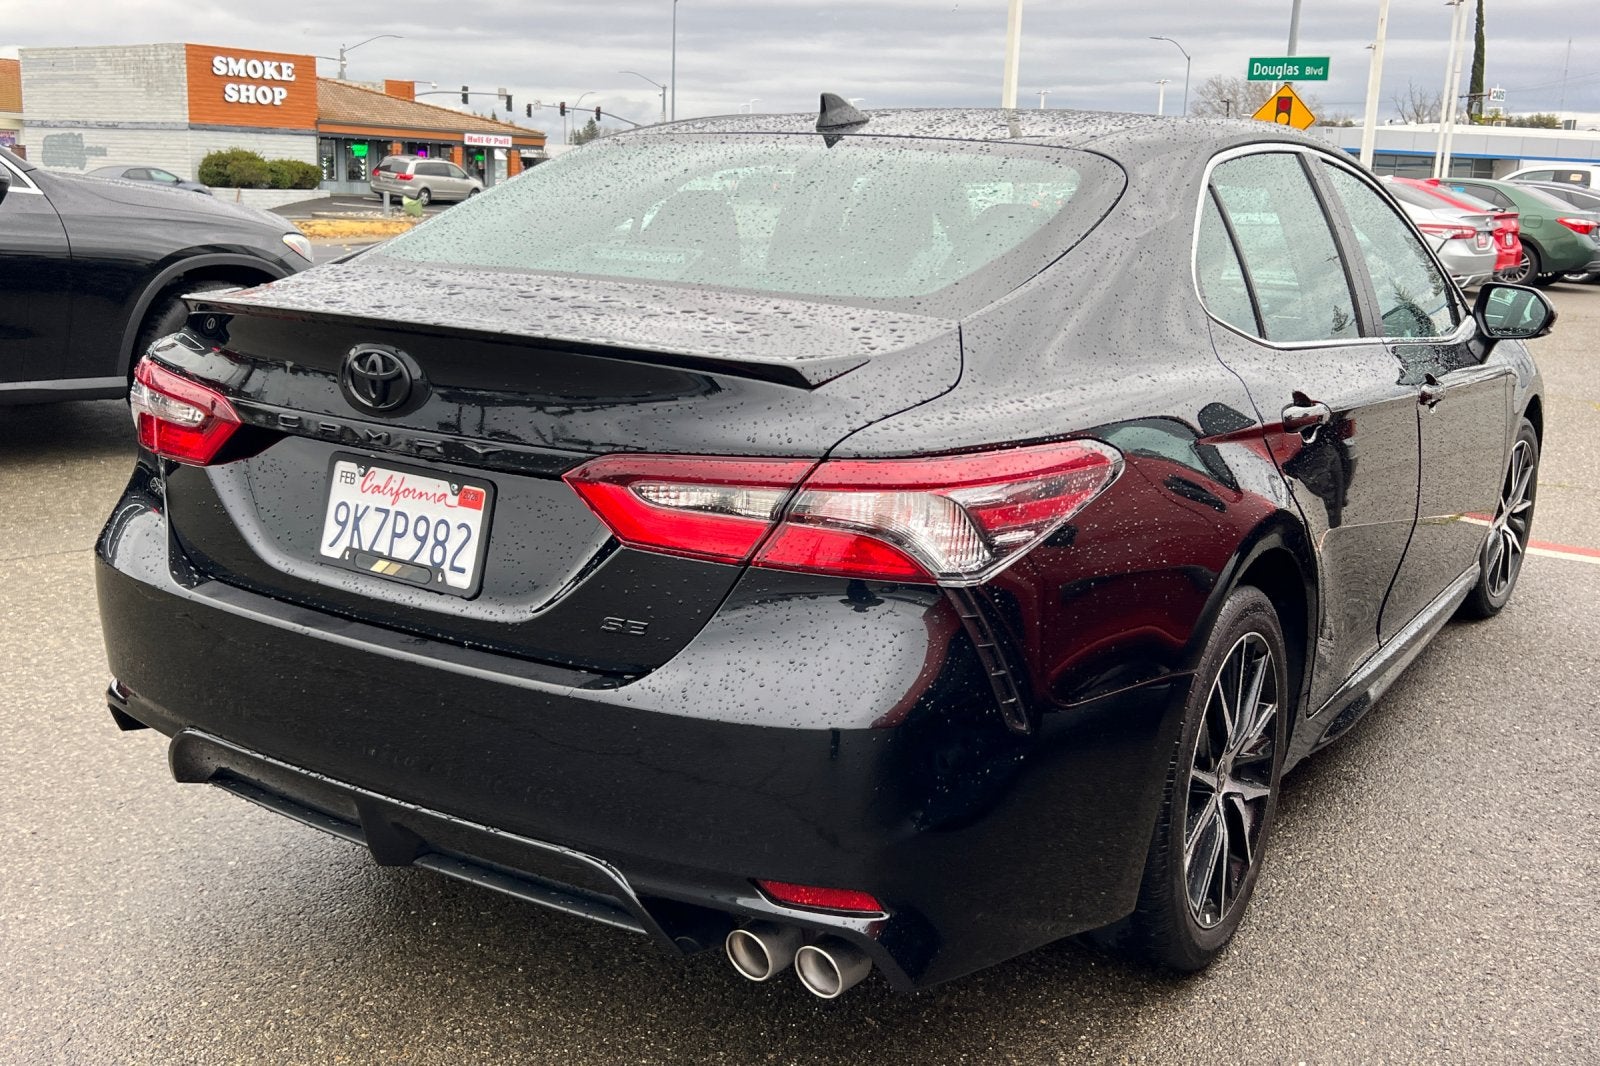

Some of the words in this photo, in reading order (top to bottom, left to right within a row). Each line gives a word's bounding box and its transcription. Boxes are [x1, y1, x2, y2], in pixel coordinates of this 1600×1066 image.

[212, 55, 296, 81] SMOKE
[1253, 62, 1299, 79] Douglas
[1305, 66, 1324, 75] Blvd
[224, 83, 288, 106] SHOP
[339, 470, 356, 485] FEB
[360, 470, 458, 507] California
[328, 500, 472, 574] 9KZP982
[601, 616, 649, 635] SE
